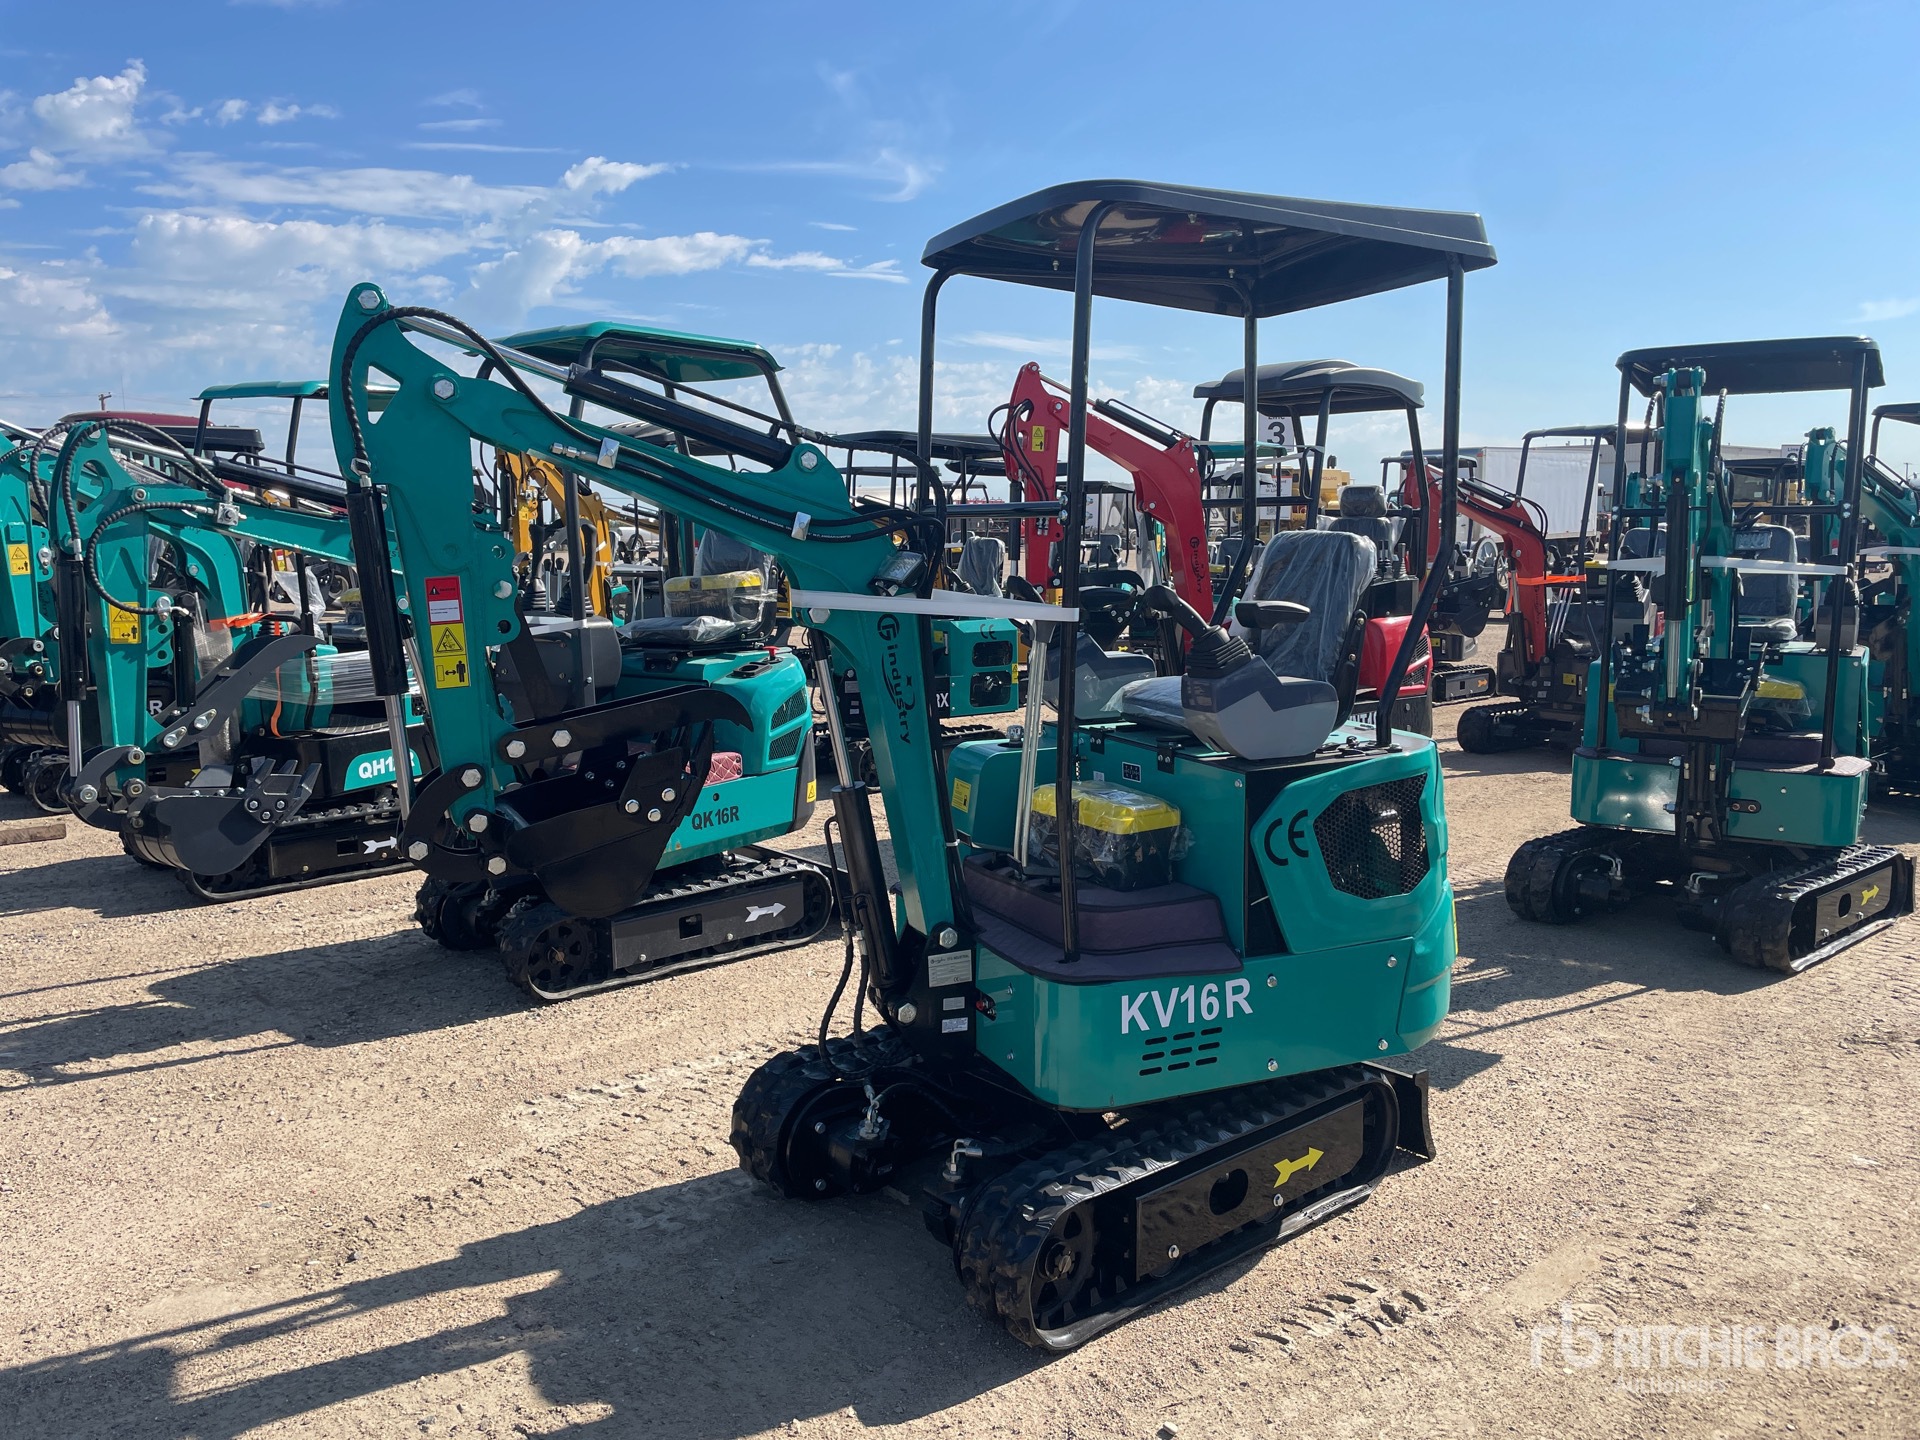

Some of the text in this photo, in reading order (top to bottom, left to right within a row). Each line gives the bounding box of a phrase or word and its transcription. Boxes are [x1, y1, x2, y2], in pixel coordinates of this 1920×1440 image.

[1267, 421, 1285, 446] 3
[691, 805, 740, 830] QK16R
[1264, 809, 1309, 866] CE
[1121, 978, 1254, 1034] KV16R
